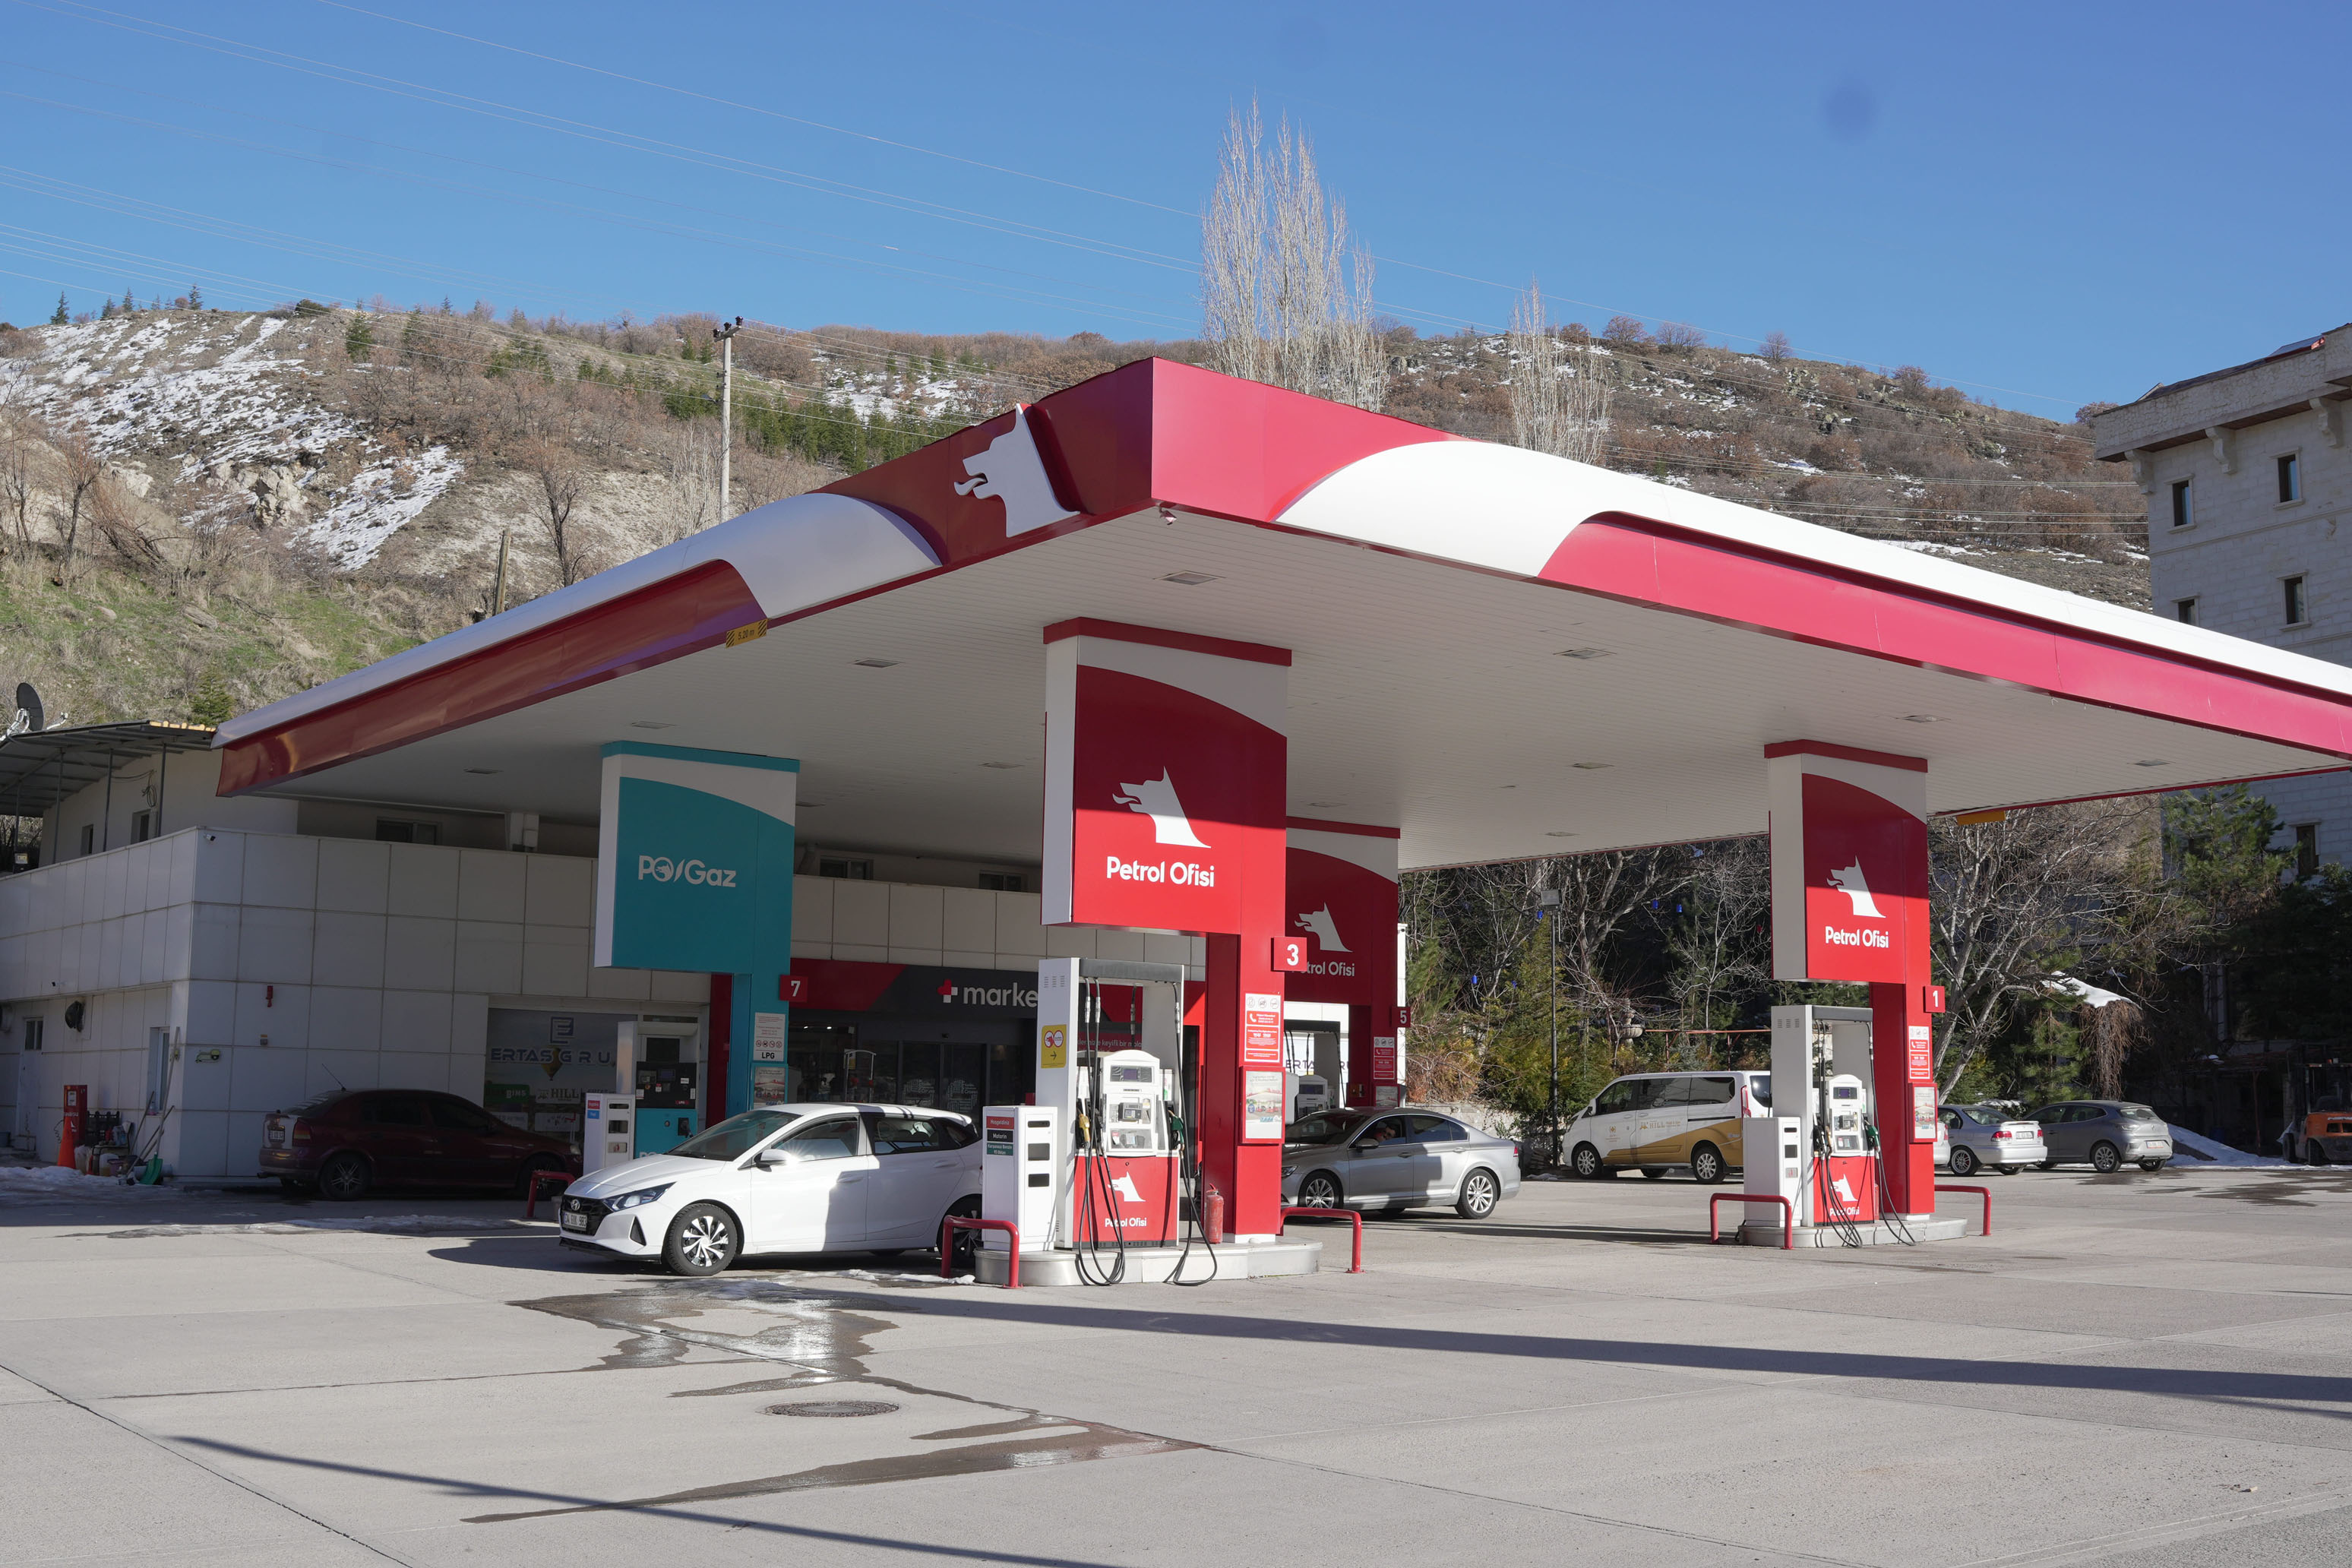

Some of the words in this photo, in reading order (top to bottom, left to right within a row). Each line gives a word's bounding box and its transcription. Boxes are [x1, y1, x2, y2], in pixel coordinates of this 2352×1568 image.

[738, 630, 748, 640] 5.20
[1106, 855, 1165, 883] Petrol
[1170, 861, 1215, 887] Ofisi
[1825, 925, 1860, 946] Petrol
[1862, 929, 1889, 948] Ofisi
[1286, 944, 1299, 966] 3
[1300, 962, 1326, 975] trol
[1328, 961, 1355, 977] Ofisi
[790, 980, 801, 997] 7
[963, 982, 1038, 1007] marke
[1932, 990, 1939, 1007] 1
[1400, 1010, 1407, 1024] 5
[551, 1088, 579, 1099] HILL
[1846, 1206, 1860, 1216] Ofisi
[1129, 1217, 1147, 1227] Ofisi
